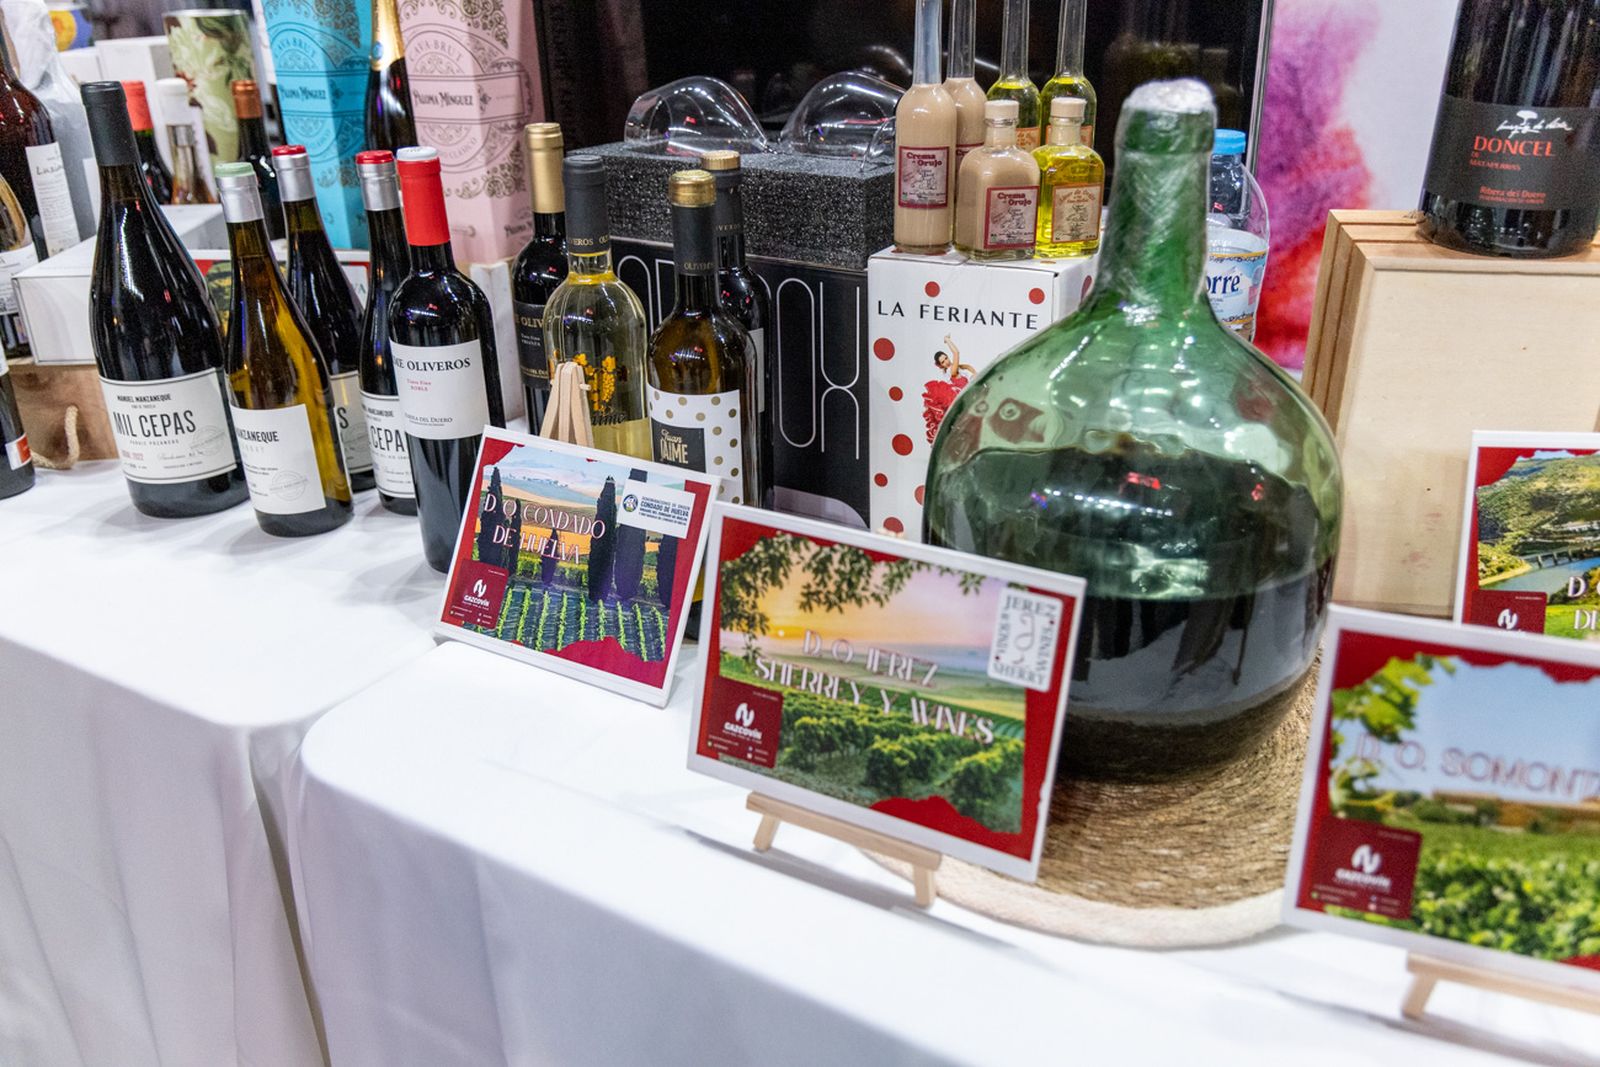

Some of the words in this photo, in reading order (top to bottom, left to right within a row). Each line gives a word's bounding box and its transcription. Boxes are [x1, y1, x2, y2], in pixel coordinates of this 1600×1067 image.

[906, 152, 936, 160] Crema
[1473, 135, 1556, 157] DONCEL
[917, 159, 942, 168] Orujo
[997, 192, 1026, 200] Crema
[1008, 199, 1032, 207] Orujo
[877, 300, 905, 317] LA
[919, 303, 1038, 330] FERIANTE
[406, 357, 471, 372] OLIVEROS
[113, 411, 137, 438] MIL
[139, 410, 196, 438] CEPAS
[660, 437, 689, 464] JAIME
[523, 503, 606, 539] CONDADO
[640, 501, 663, 512] CONDADO
[663, 505, 670, 513] DE
[671, 507, 689, 517] HUELVA
[493, 524, 517, 548] DE
[519, 532, 580, 565] HUELVA
[865, 647, 939, 689] JEREZ
[880, 687, 900, 715] Y
[910, 695, 995, 746] WINES
